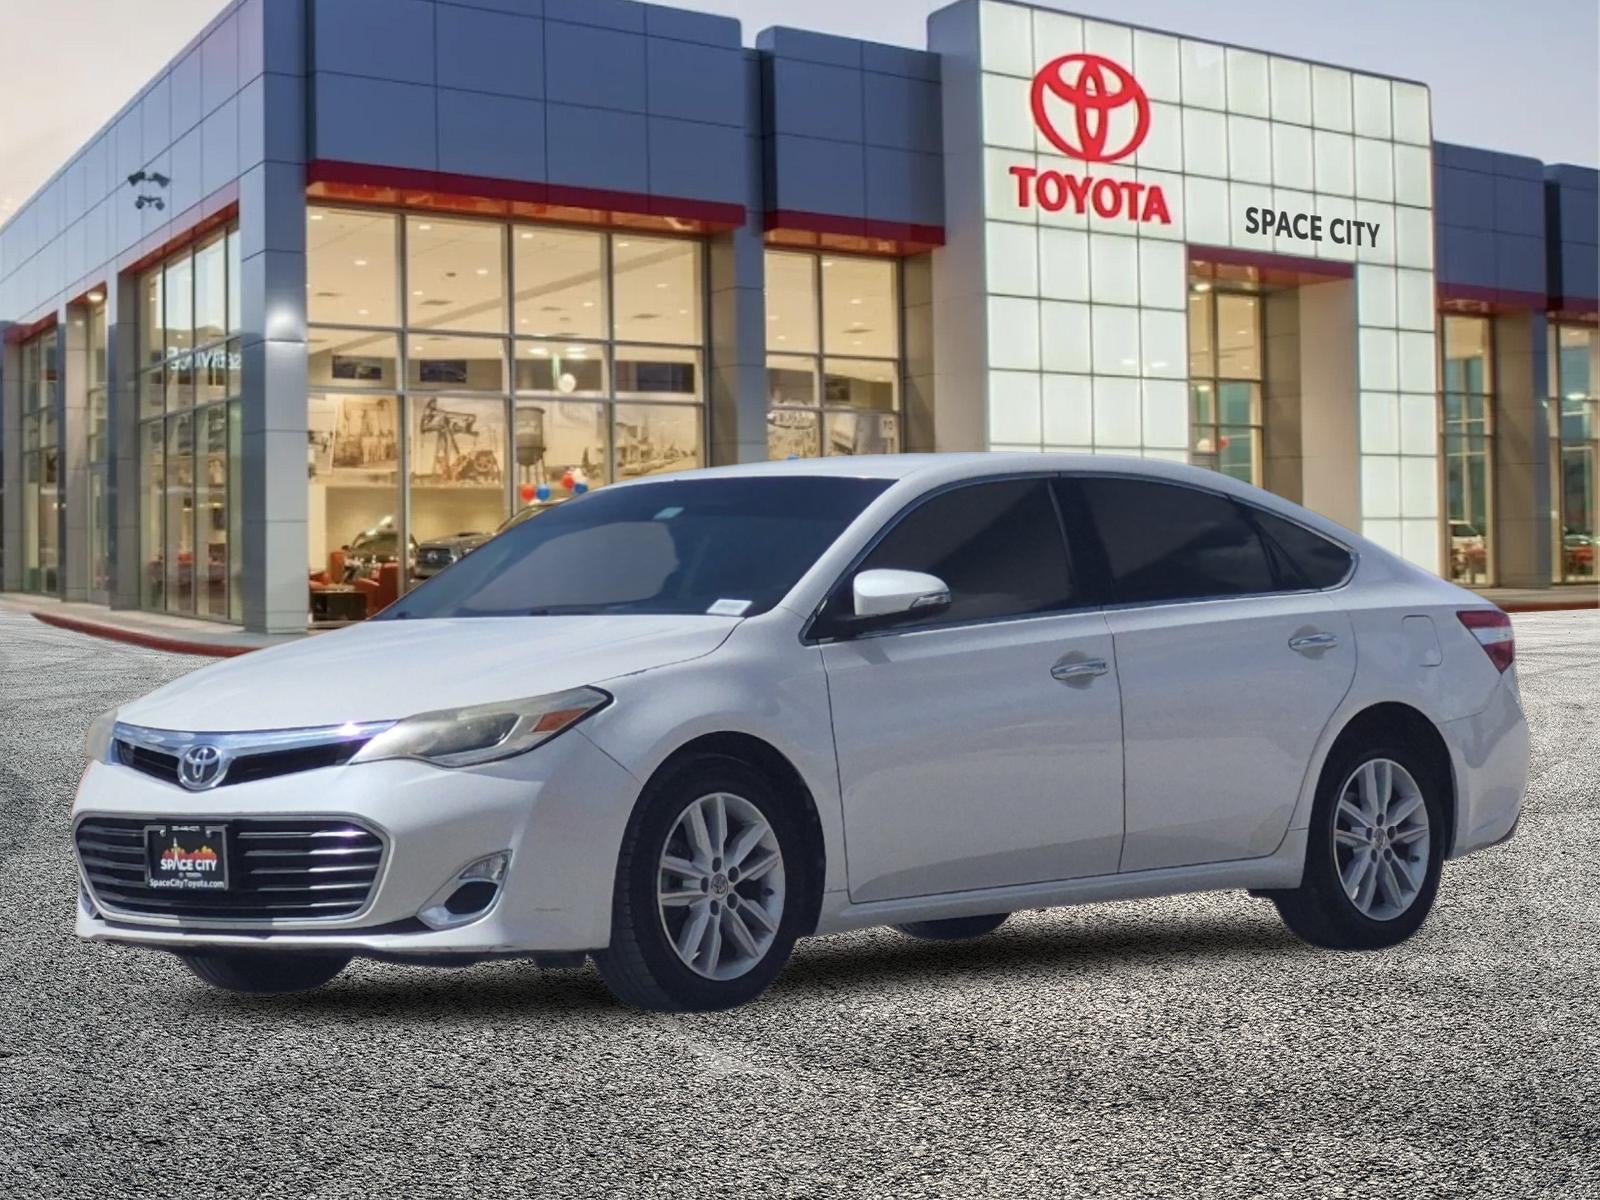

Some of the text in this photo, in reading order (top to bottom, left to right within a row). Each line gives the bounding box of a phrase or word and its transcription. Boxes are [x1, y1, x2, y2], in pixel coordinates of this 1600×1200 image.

[1009, 167, 1171, 224] TOYOTA
[1245, 206, 1381, 248] SPACE CITY
[160, 859, 217, 871] SPACE CITY
[149, 878, 225, 889] SpaceCityToyota.com
